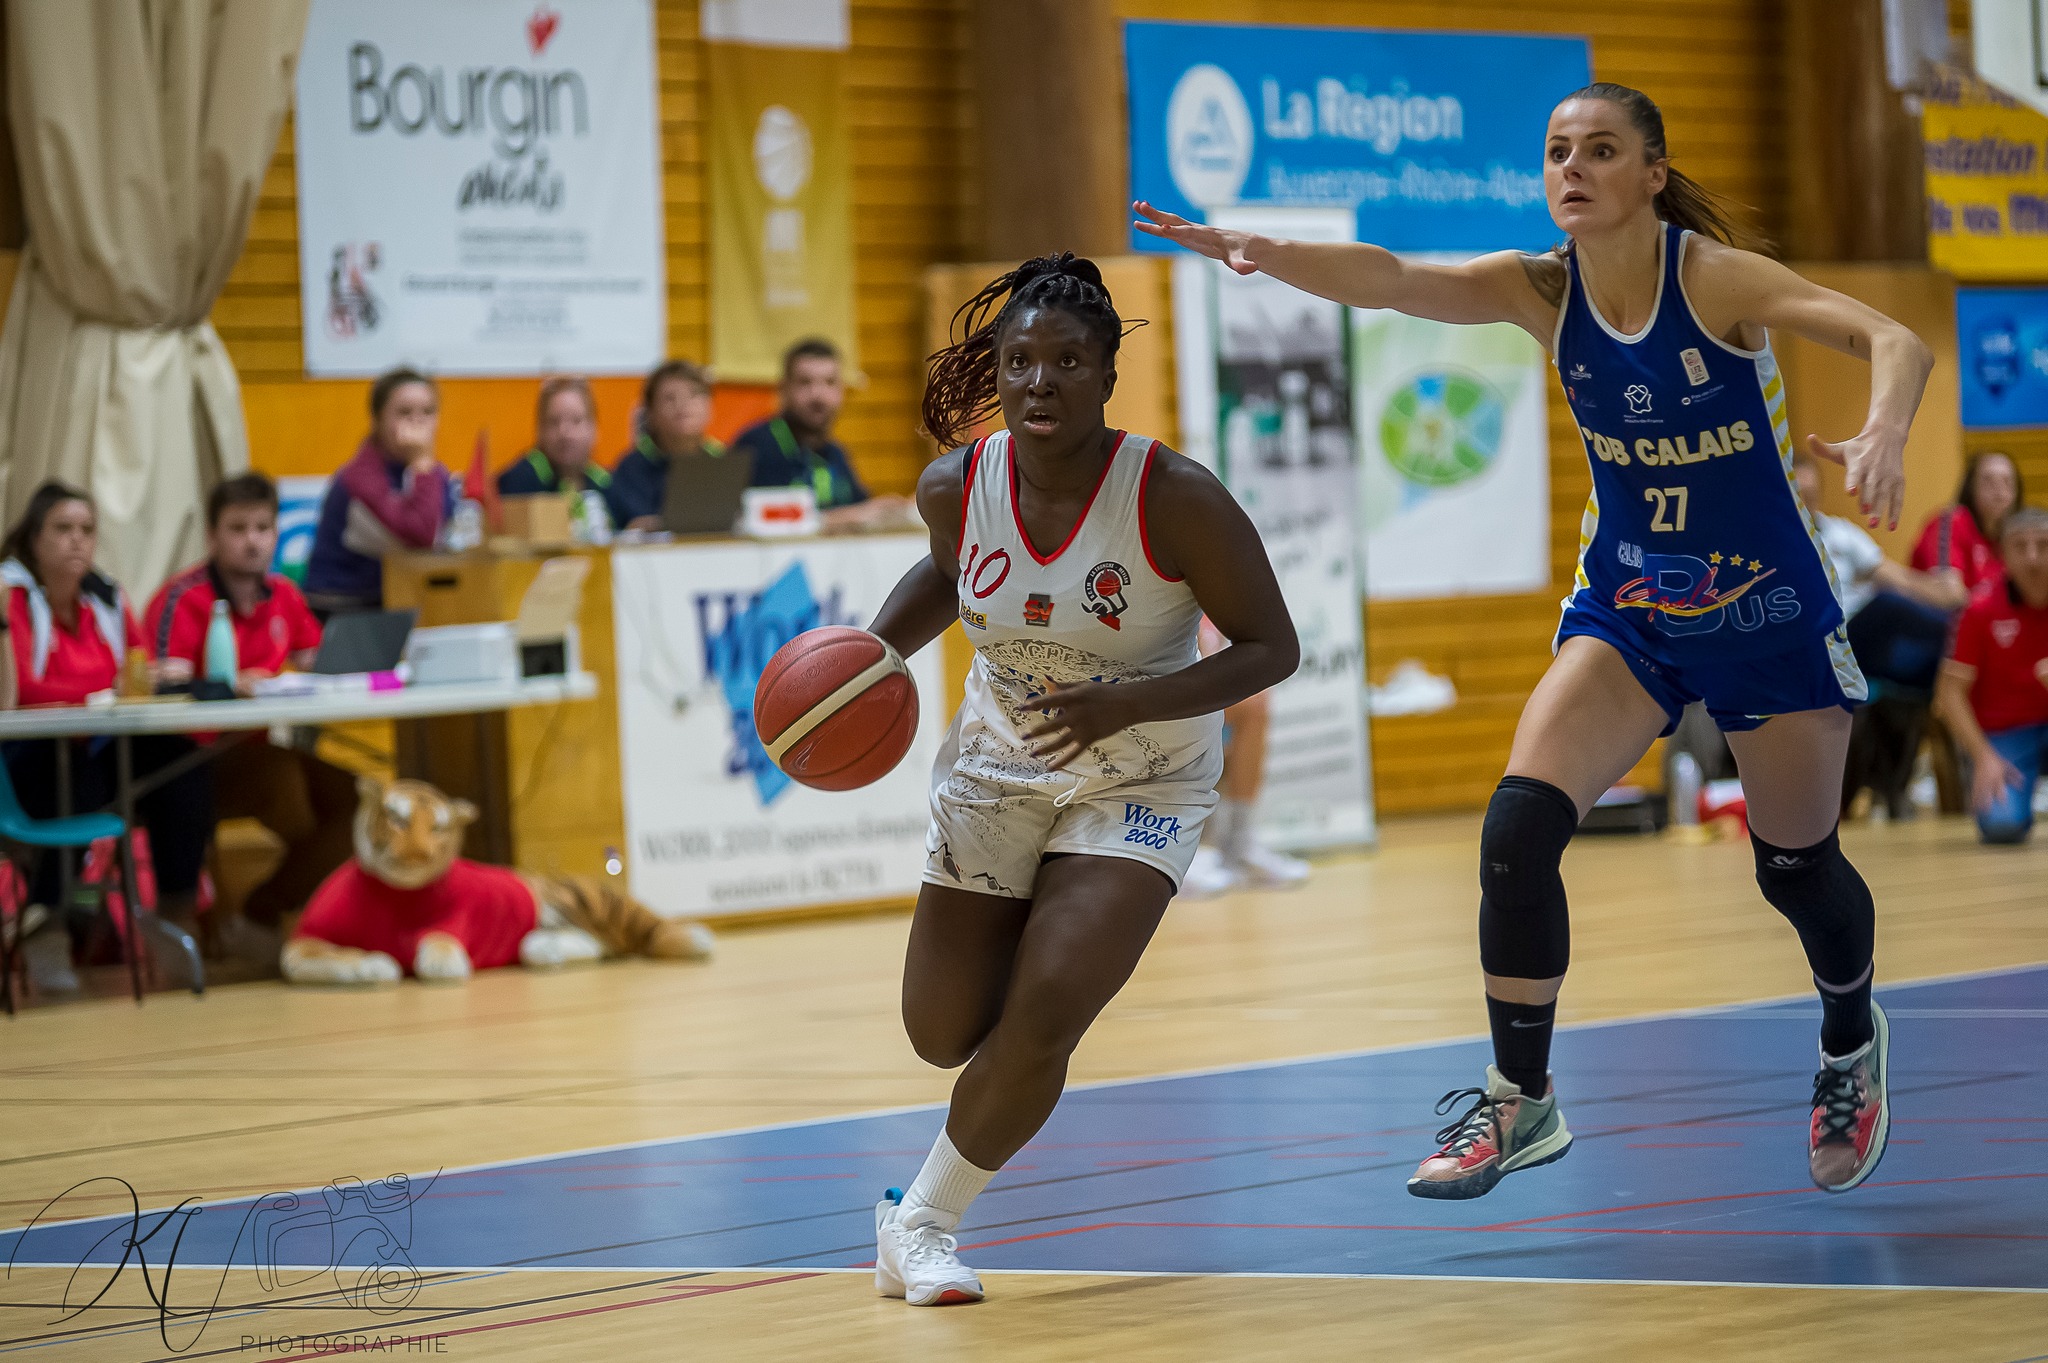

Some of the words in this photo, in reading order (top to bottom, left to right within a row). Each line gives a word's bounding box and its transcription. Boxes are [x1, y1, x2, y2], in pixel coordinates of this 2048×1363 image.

[348, 40, 591, 159] Bourgin
[1261, 76, 1309, 140] La
[1317, 76, 1465, 154] Région
[1634, 420, 1755, 467] CALAIS
[1644, 486, 1689, 533] 27
[963, 543, 1012, 599] 10
[960, 599, 985, 625] Isère
[1123, 802, 1183, 845] Work
[1124, 828, 1168, 850] 2000
